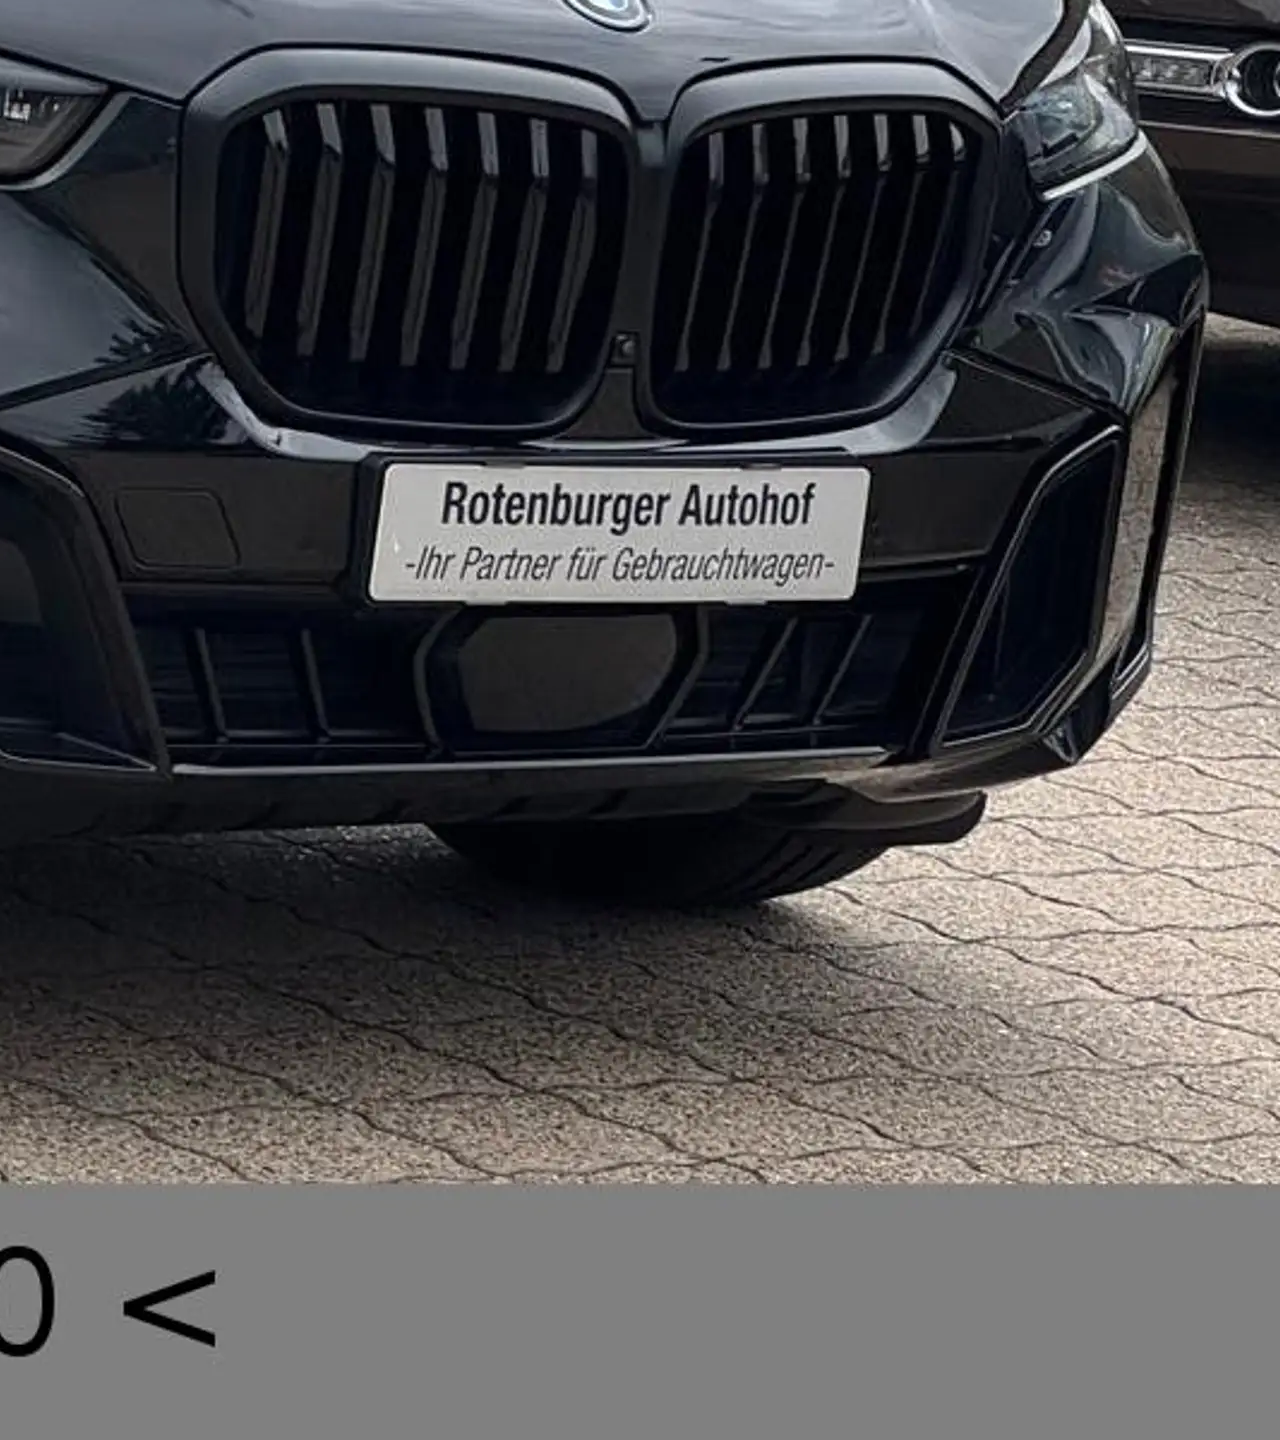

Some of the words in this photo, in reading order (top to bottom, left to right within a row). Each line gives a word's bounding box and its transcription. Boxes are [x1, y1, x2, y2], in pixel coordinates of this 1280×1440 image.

[441, 481, 670, 536] Rotenburger
[678, 482, 816, 526] Autohof
[459, 546, 558, 580] Partner
[564, 547, 607, 580] für
